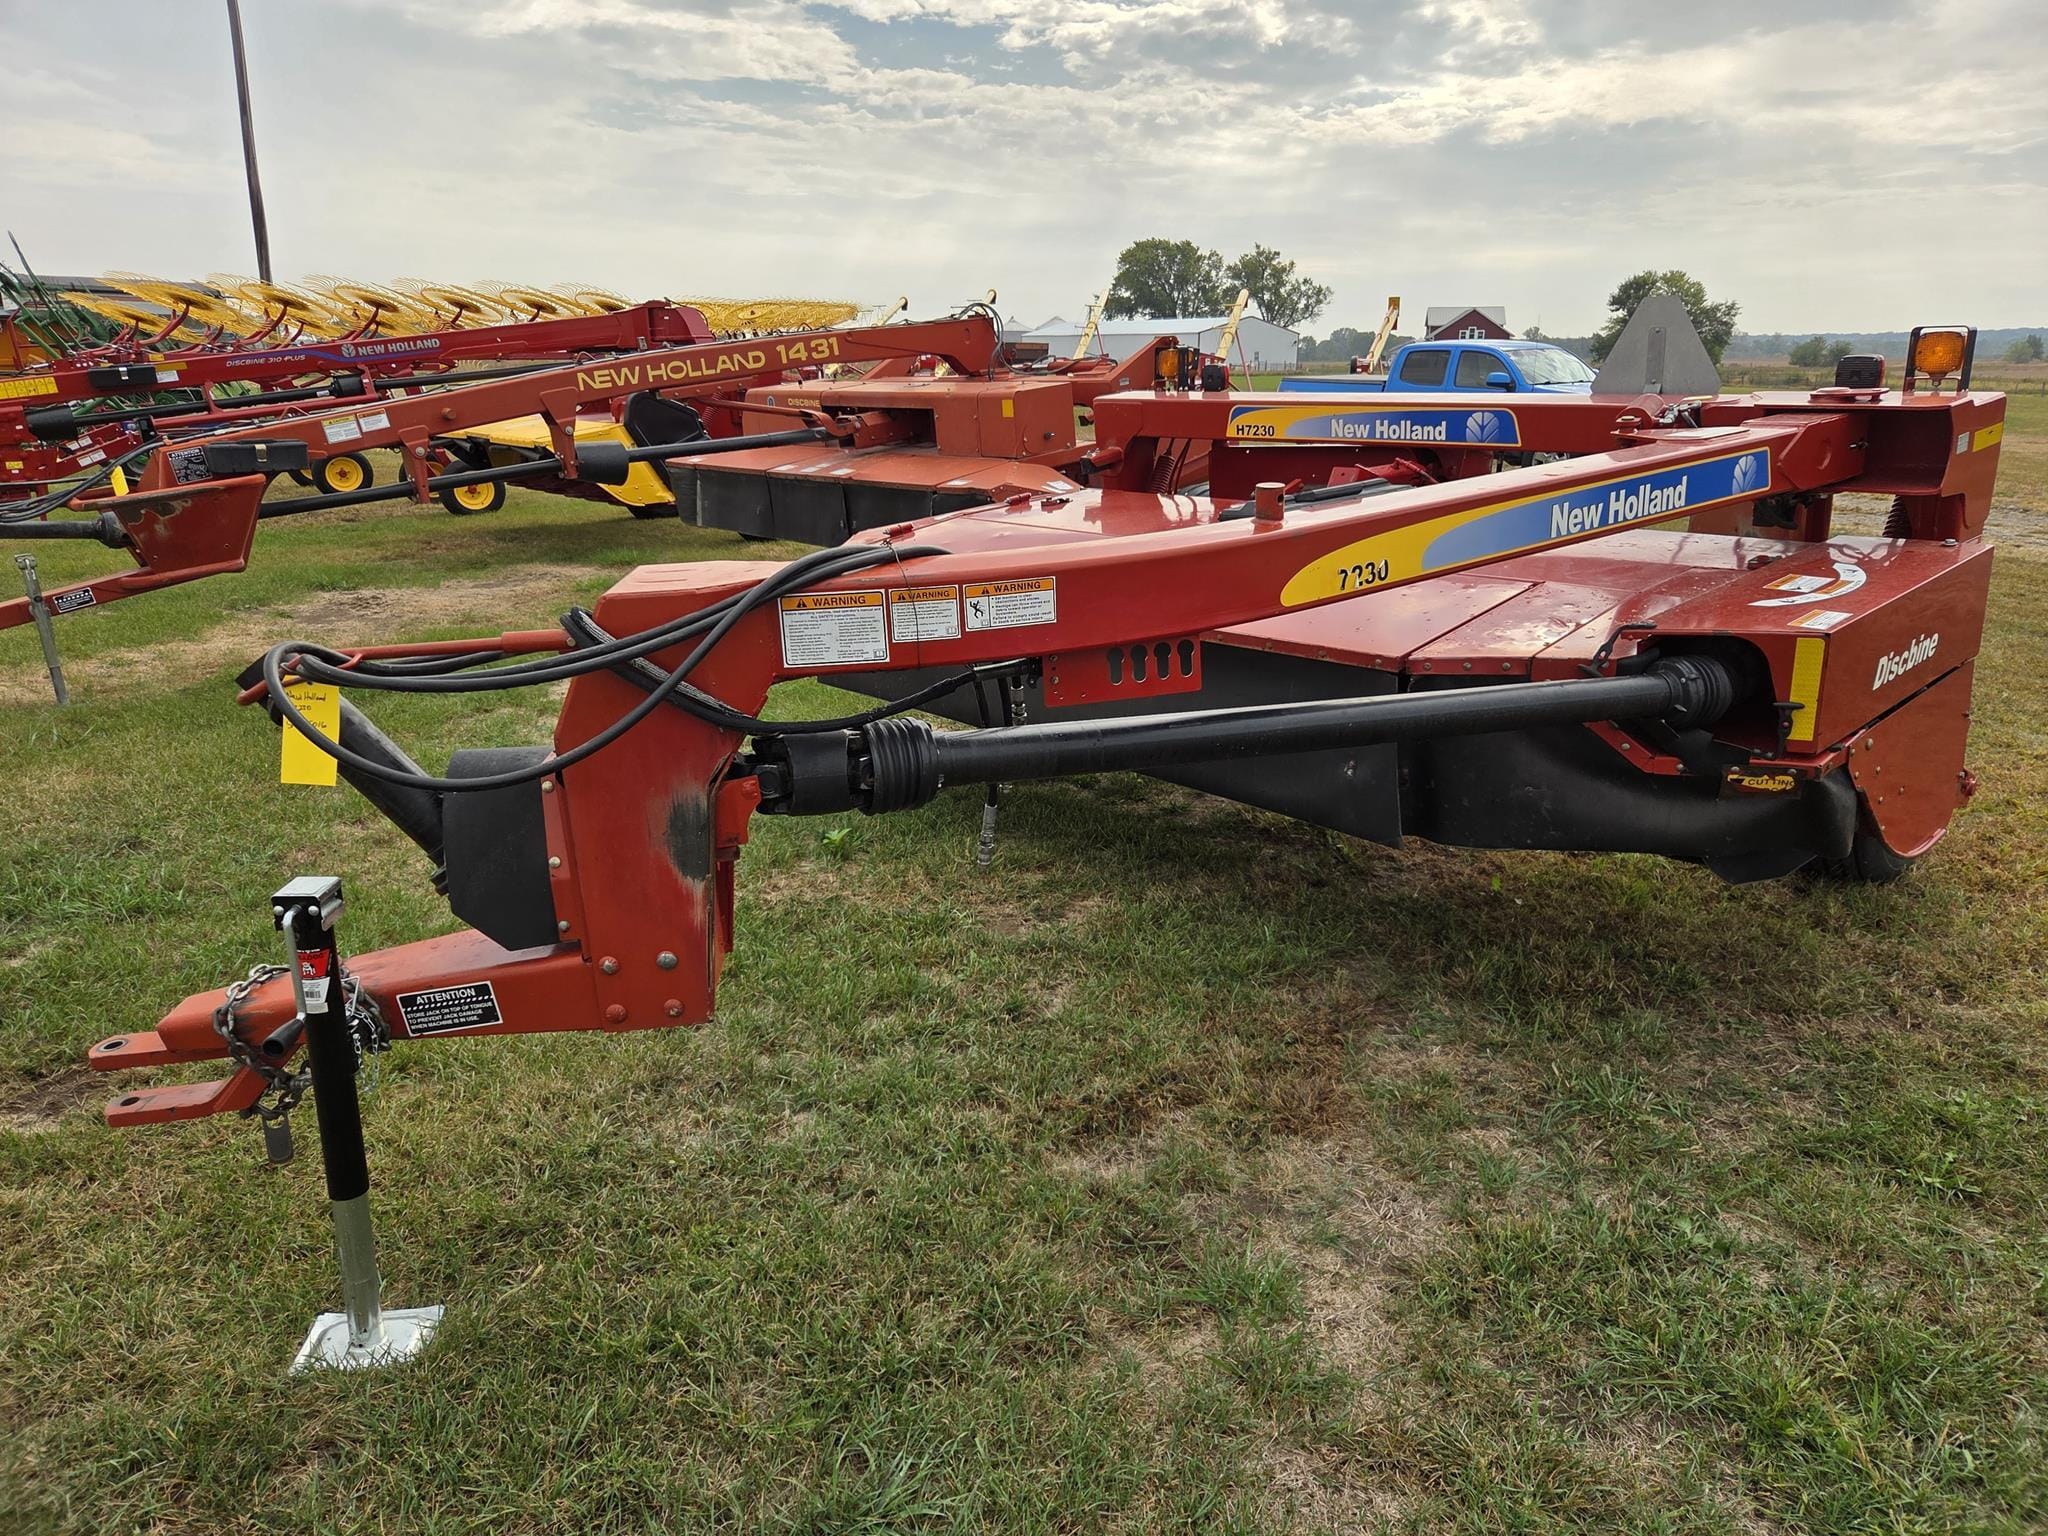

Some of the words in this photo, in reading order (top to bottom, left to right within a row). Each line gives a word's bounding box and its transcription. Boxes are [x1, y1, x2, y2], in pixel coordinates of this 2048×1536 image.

[358, 344, 384, 355] NEW
[387, 339, 440, 352] HOLLAND
[226, 358, 266, 367] DISCBINE
[577, 366, 640, 392] NEW
[647, 350, 765, 383] HOLLAND
[776, 336, 840, 364] 1431
[788, 399, 820, 407] DISCBINE
[1236, 424, 1274, 437] H7230
[1331, 419, 1368, 438] New
[1376, 420, 1446, 440] Holland
[1550, 495, 1603, 539] New
[1608, 476, 1688, 524] Holland
[994, 582, 1041, 592] WARNING
[812, 596, 866, 606] WARNING
[908, 590, 950, 600] WARNING
[1873, 633, 1939, 691] Discbine
[416, 988, 476, 1004] ATTENTION
[418, 1015, 442, 1024] PREVENT
